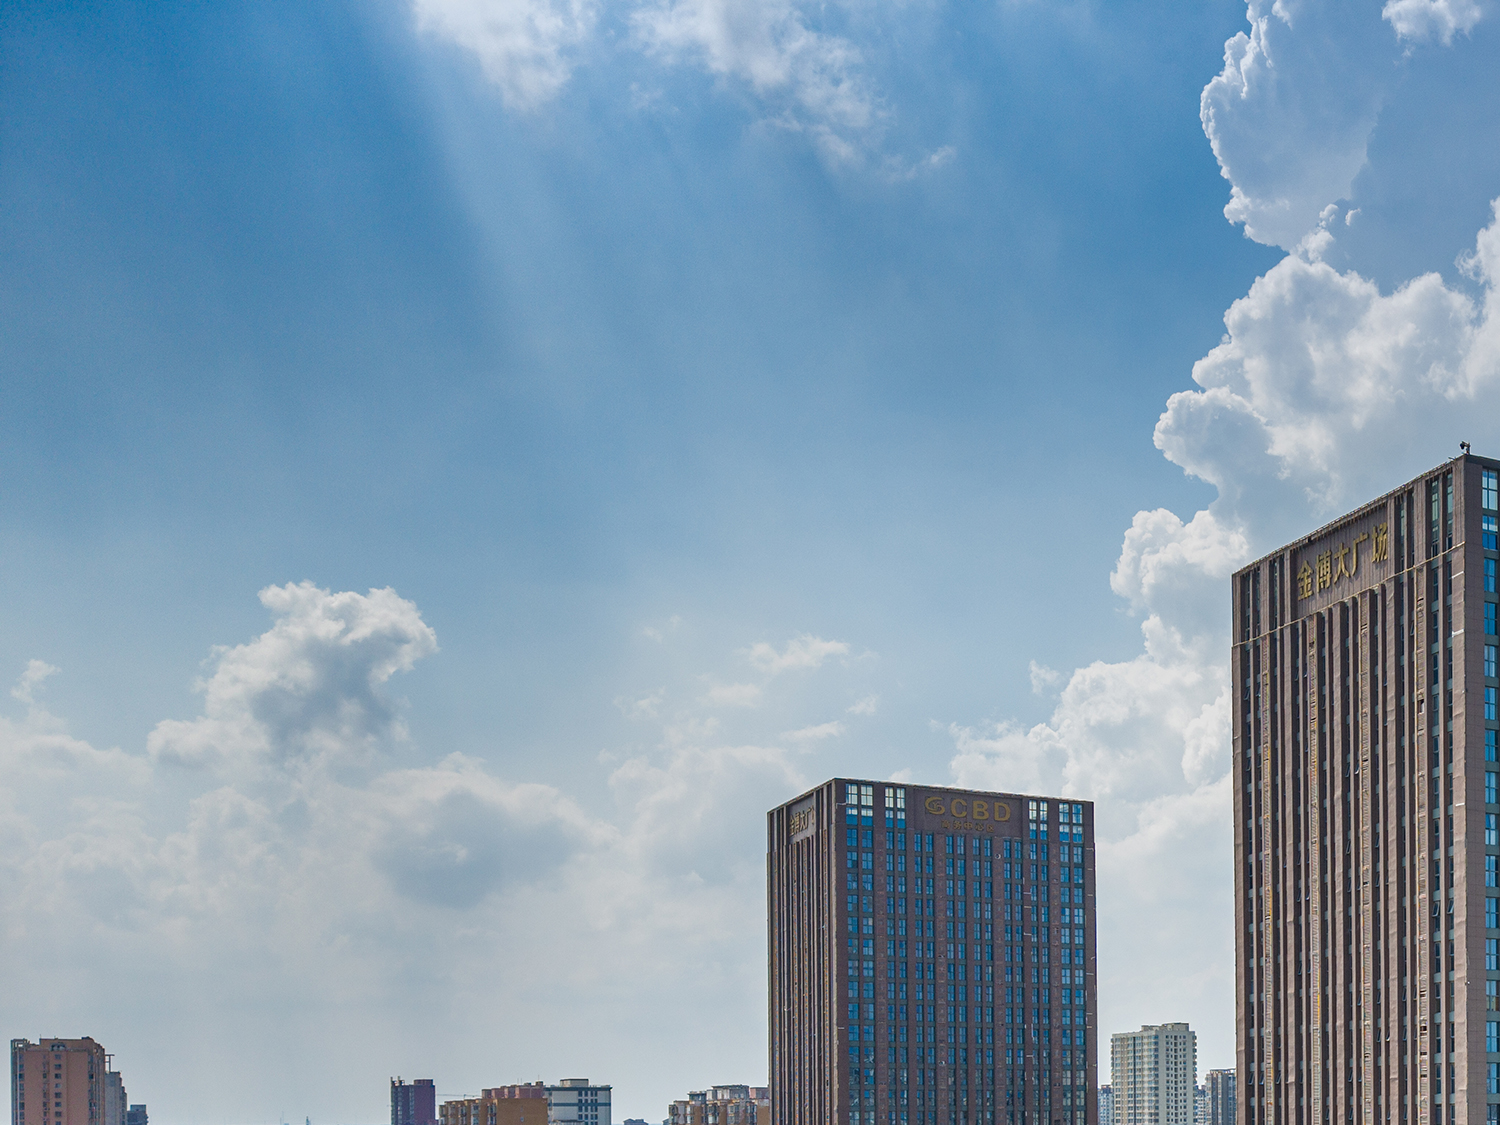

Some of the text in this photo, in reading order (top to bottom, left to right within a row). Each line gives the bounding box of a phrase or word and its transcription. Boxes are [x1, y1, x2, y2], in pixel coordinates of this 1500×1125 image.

[1297, 522, 1388, 600] 金博大广场
